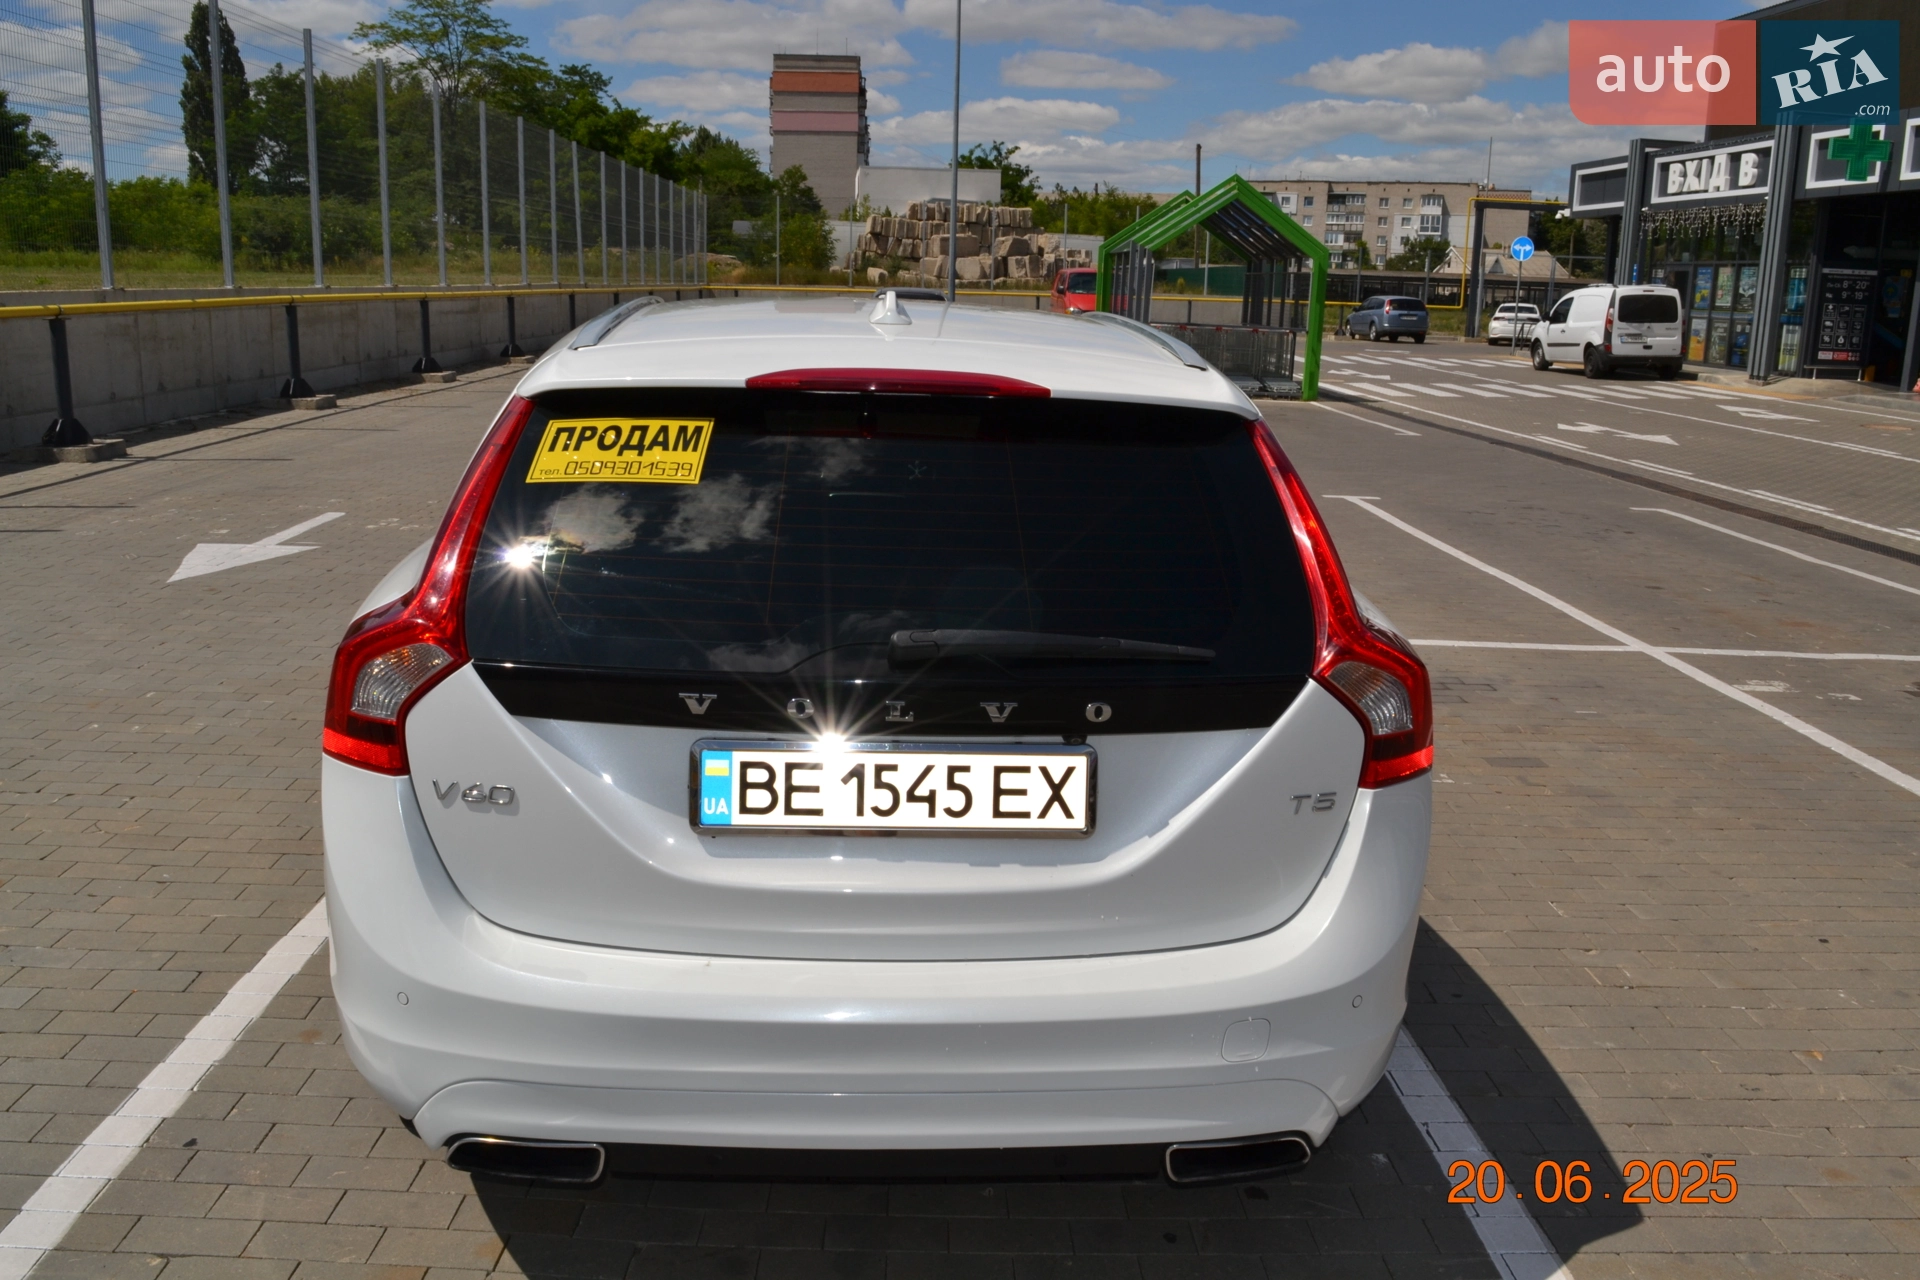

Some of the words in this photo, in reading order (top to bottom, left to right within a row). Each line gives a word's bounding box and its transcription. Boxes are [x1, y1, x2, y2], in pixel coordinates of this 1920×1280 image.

[1667, 153, 1732, 194] ВХІД
[1738, 152, 1759, 187] В
[547, 424, 705, 457] ПРОДАМ
[538, 468, 562, 476] тел.
[564, 460, 693, 477] 0509301539
[678, 692, 1112, 723] VOLVO
[432, 779, 516, 806] V60
[738, 760, 824, 816] BE
[840, 763, 973, 819] 1545
[992, 765, 1077, 820] EX
[1290, 792, 1337, 815] T5
[703, 797, 729, 815] UA
